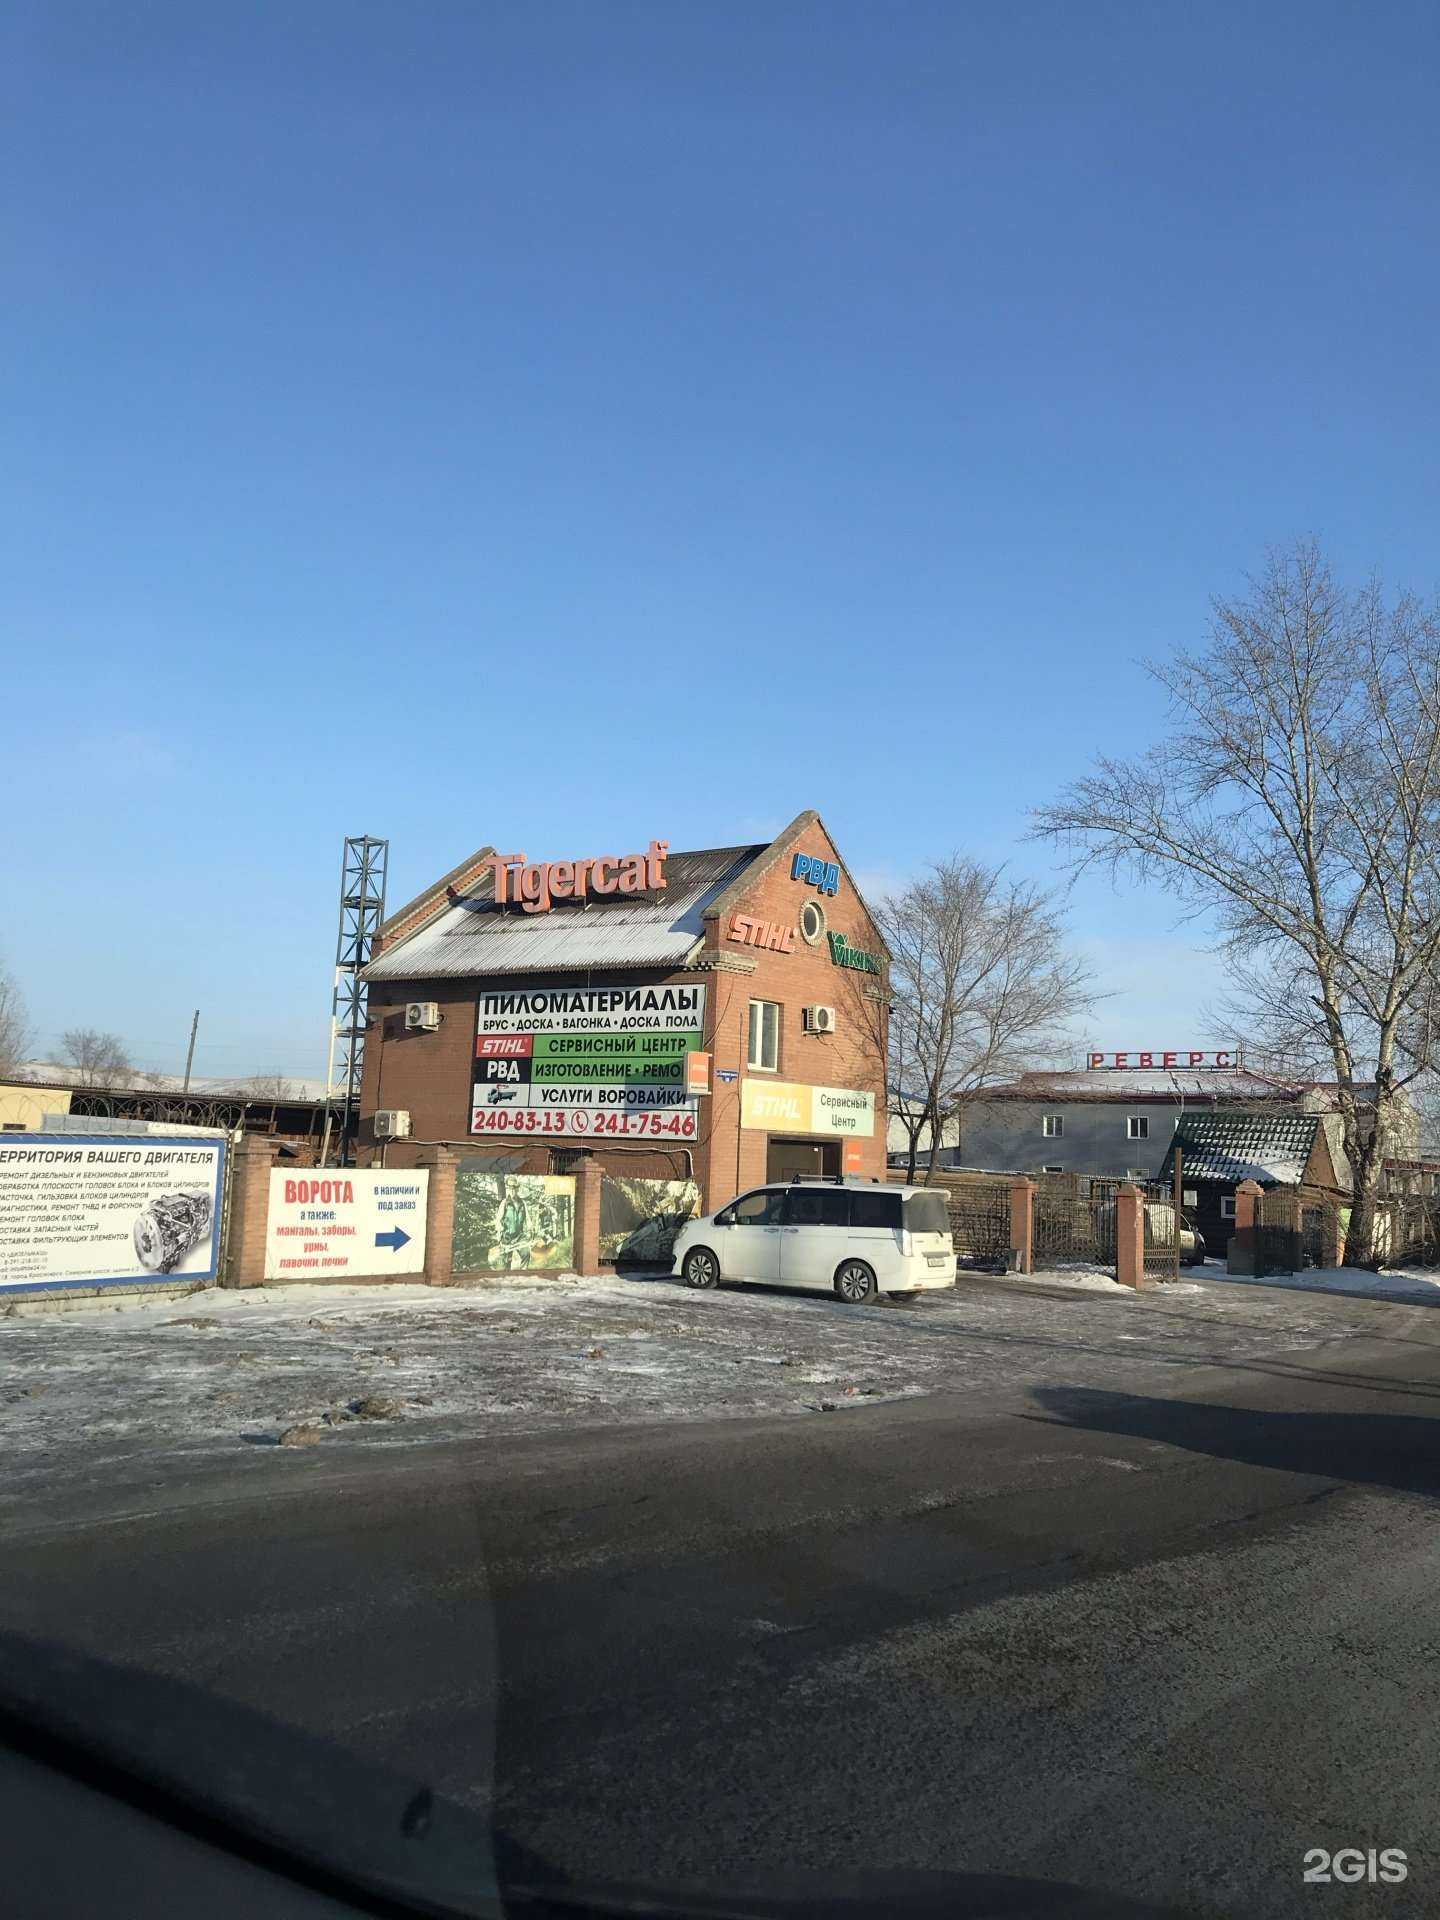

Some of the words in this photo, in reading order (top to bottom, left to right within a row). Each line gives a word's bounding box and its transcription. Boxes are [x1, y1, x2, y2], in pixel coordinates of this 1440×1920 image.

[485, 840, 668, 914] Tigercat
[791, 853, 840, 897] РВД
[727, 914, 796, 954] STIHL
[484, 988, 698, 1015] ПИЛОМАТЕРИАЛЫ
[483, 1020, 509, 1030] БРУС
[516, 1018, 553, 1031] ДОСКА
[562, 1017, 611, 1029] ВАГОНКА
[620, 1016, 661, 1028] ДОСКА
[665, 1015, 698, 1028] ПОЛА
[481, 1039, 526, 1053] STIHL
[549, 1035, 636, 1052] СЕРВИСНЫЙ
[642, 1038, 687, 1054] ЦЕНТР
[1091, 1052, 1230, 1069] РЕВЕРС
[487, 1060, 520, 1081] РВД
[535, 1063, 631, 1078] ИЗГОТОВЛЕНИЕ
[643, 1063, 684, 1078] РЕМО
[542, 1088, 592, 1103] УСЛУГИ
[599, 1086, 686, 1105] ВОРОВАЙКИ
[820, 1093, 868, 1110] Сервисный
[751, 1096, 801, 1119] STIHL
[474, 1110, 565, 1131] 240-83-13
[593, 1113, 695, 1135] 241-75-46
[831, 1114, 856, 1129] Центр
[0, 1150, 83, 1163] ЕРРИТОРИЯ
[86, 1151, 141, 1164] ВАШЕГО
[144, 1152, 213, 1165] ДВИГАТЕЛЯ
[285, 1180, 354, 1204] ВОРОТА
[381, 1185, 413, 1196] наличии
[0, 1204, 48, 1212] ИАГНОСТИКА,
[307, 1210, 336, 1220] также:
[378, 1201, 393, 1212] под
[394, 1201, 416, 1211] заказ
